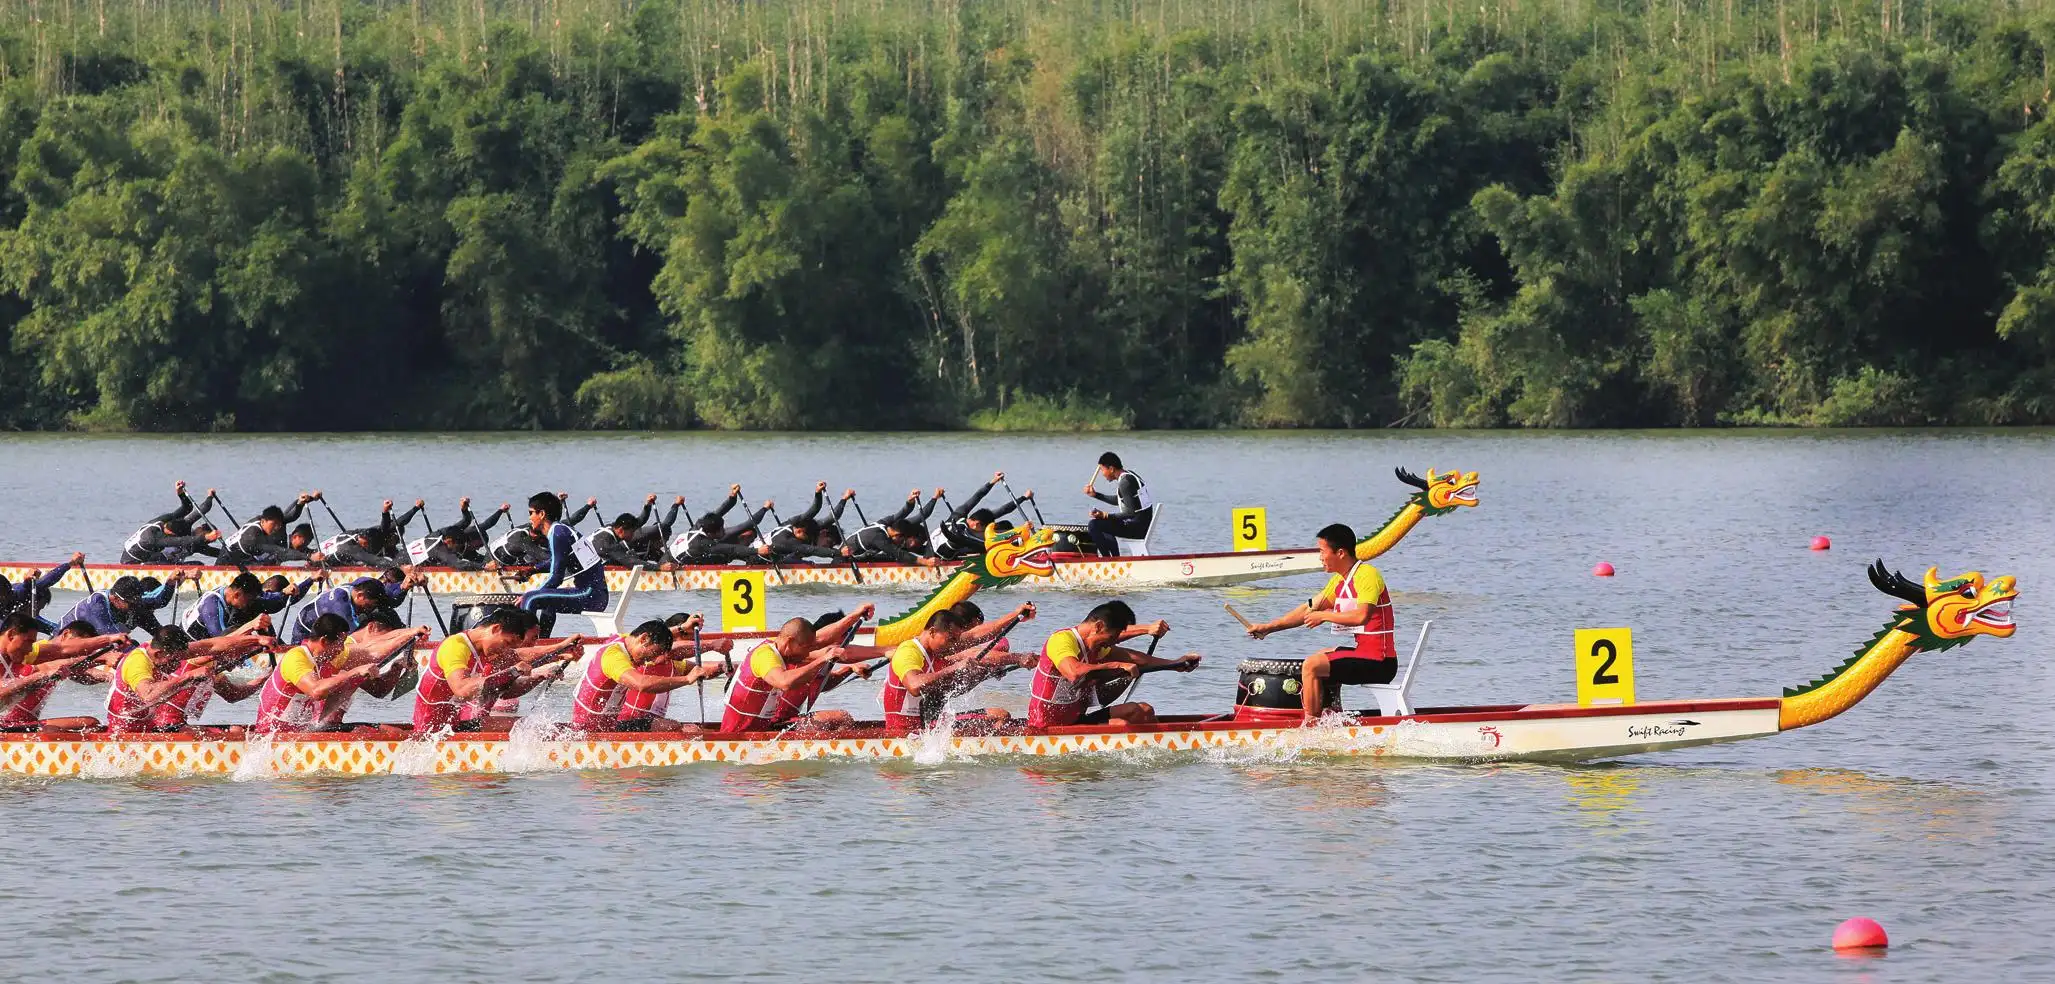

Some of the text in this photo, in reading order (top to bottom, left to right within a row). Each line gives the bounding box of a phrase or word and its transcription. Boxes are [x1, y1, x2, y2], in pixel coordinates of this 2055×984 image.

[1243, 514, 1257, 541] 5
[733, 578, 753, 614] 3
[1591, 639, 1619, 685] 2
[1628, 725, 1685, 739] Swift Racing
